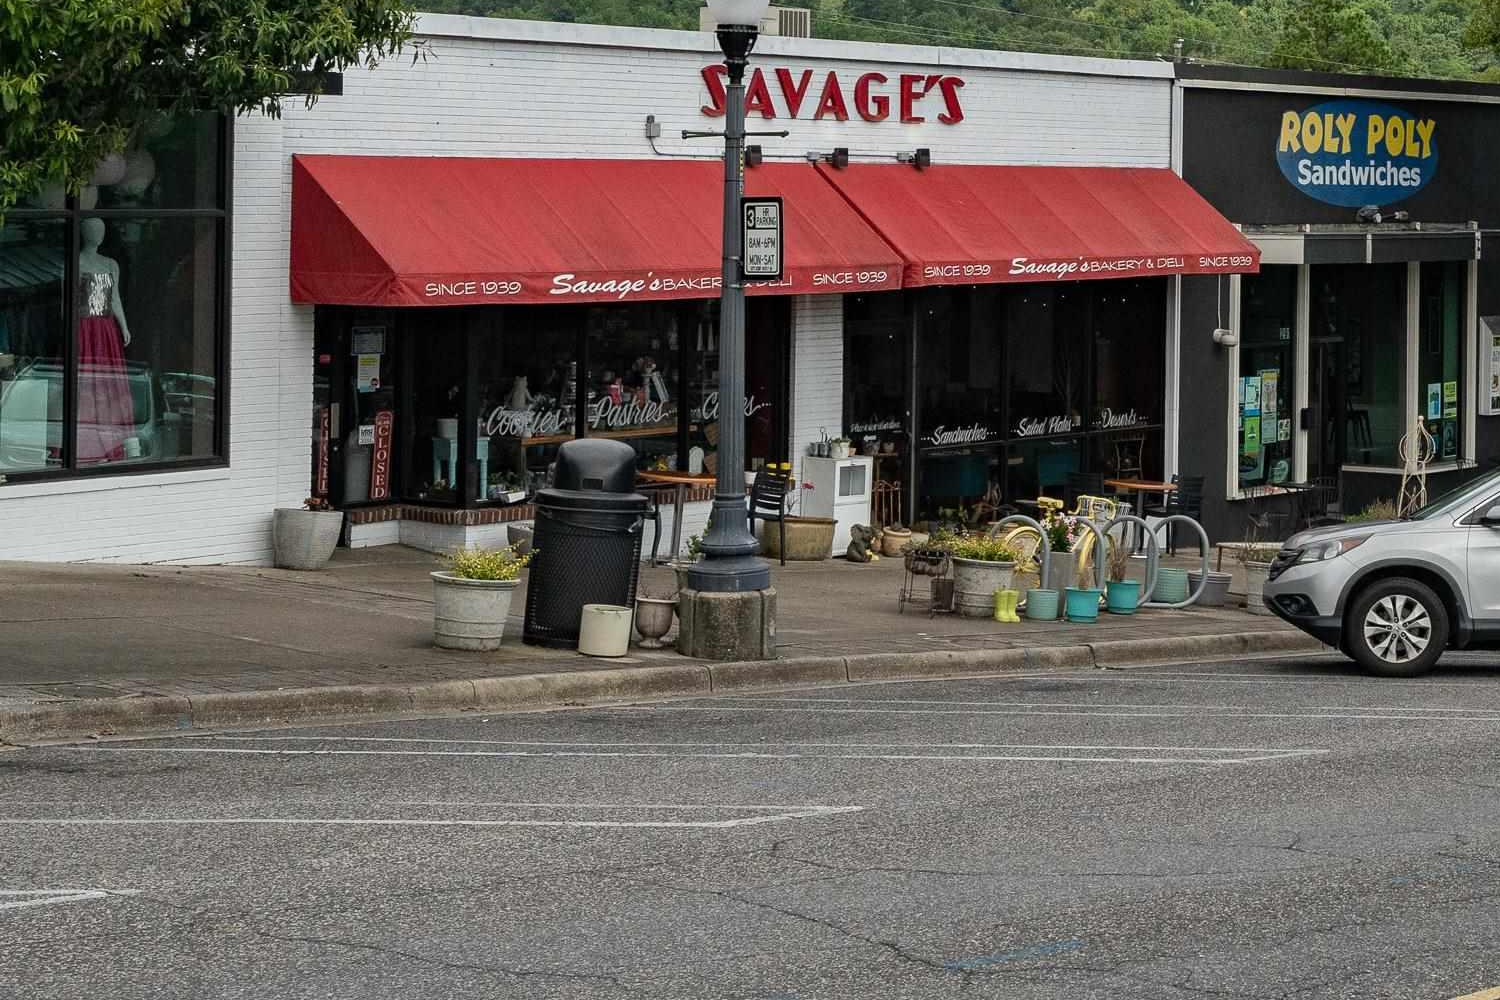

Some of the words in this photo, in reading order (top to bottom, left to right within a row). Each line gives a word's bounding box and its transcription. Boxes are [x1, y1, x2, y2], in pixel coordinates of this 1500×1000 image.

[700, 64, 965, 125] SAVAGE'S
[1279, 110, 1357, 154] ROLY
[1367, 114, 1437, 160] POLY
[1297, 158, 1422, 187] Sandwiches
[747, 209, 755, 228] 3
[756, 216, 777, 226] PARKING
[762, 207, 770, 216] HR
[748, 254, 775, 266] MON-SAT
[924, 265, 961, 278] SINCE
[962, 264, 992, 276] 1939
[1008, 256, 1091, 280] Savage's
[1091, 258, 1144, 272] BAKERY
[1146, 258, 1154, 269] &
[1156, 257, 1184, 269] DELI
[1199, 256, 1228, 267] SINCE
[1229, 256, 1253, 267] 1939
[425, 282, 478, 297] SINCE
[480, 281, 522, 295] 1939
[549, 271, 663, 300] Savage's
[663, 276, 722, 291] BAKER
[812, 272, 853, 286] SINCE
[855, 271, 888, 284] 1939
[374, 424, 391, 498] CLOSED
